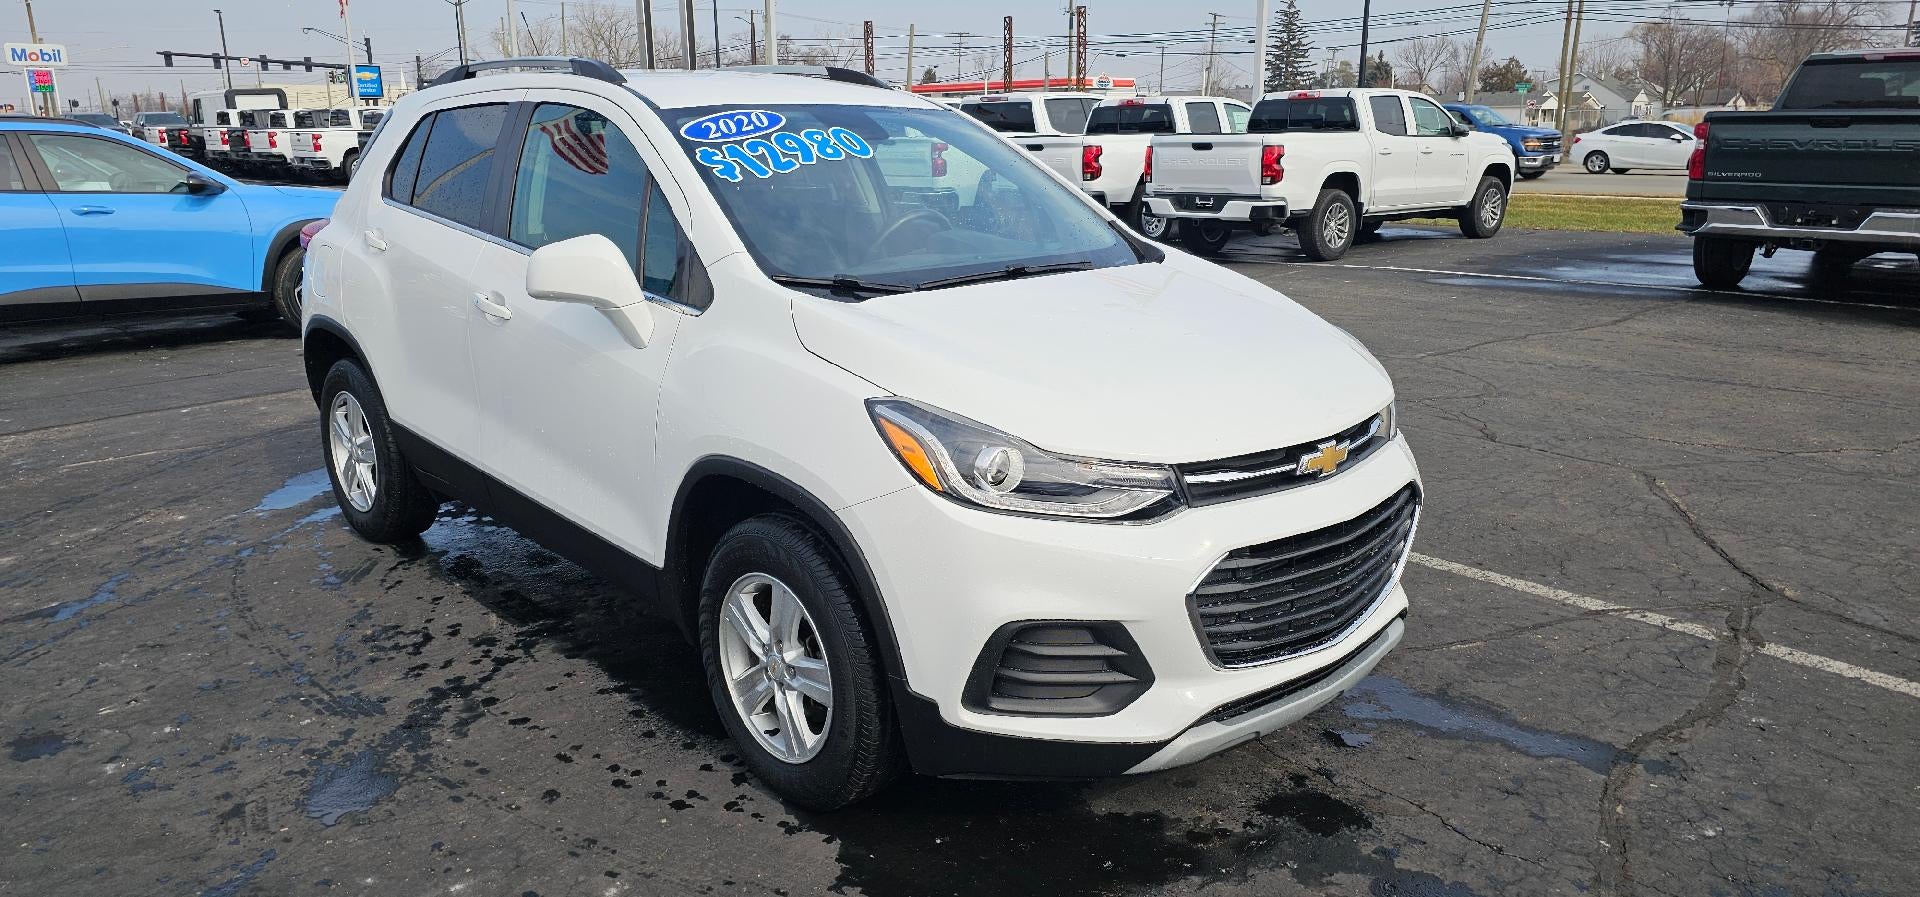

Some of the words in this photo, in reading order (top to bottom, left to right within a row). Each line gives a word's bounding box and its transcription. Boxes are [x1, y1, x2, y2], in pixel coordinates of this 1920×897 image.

[10, 47, 62, 62] Mobil
[701, 111, 769, 139] 2020
[696, 127, 874, 182] $12980
[1720, 138, 1920, 151] CHEVROLE
